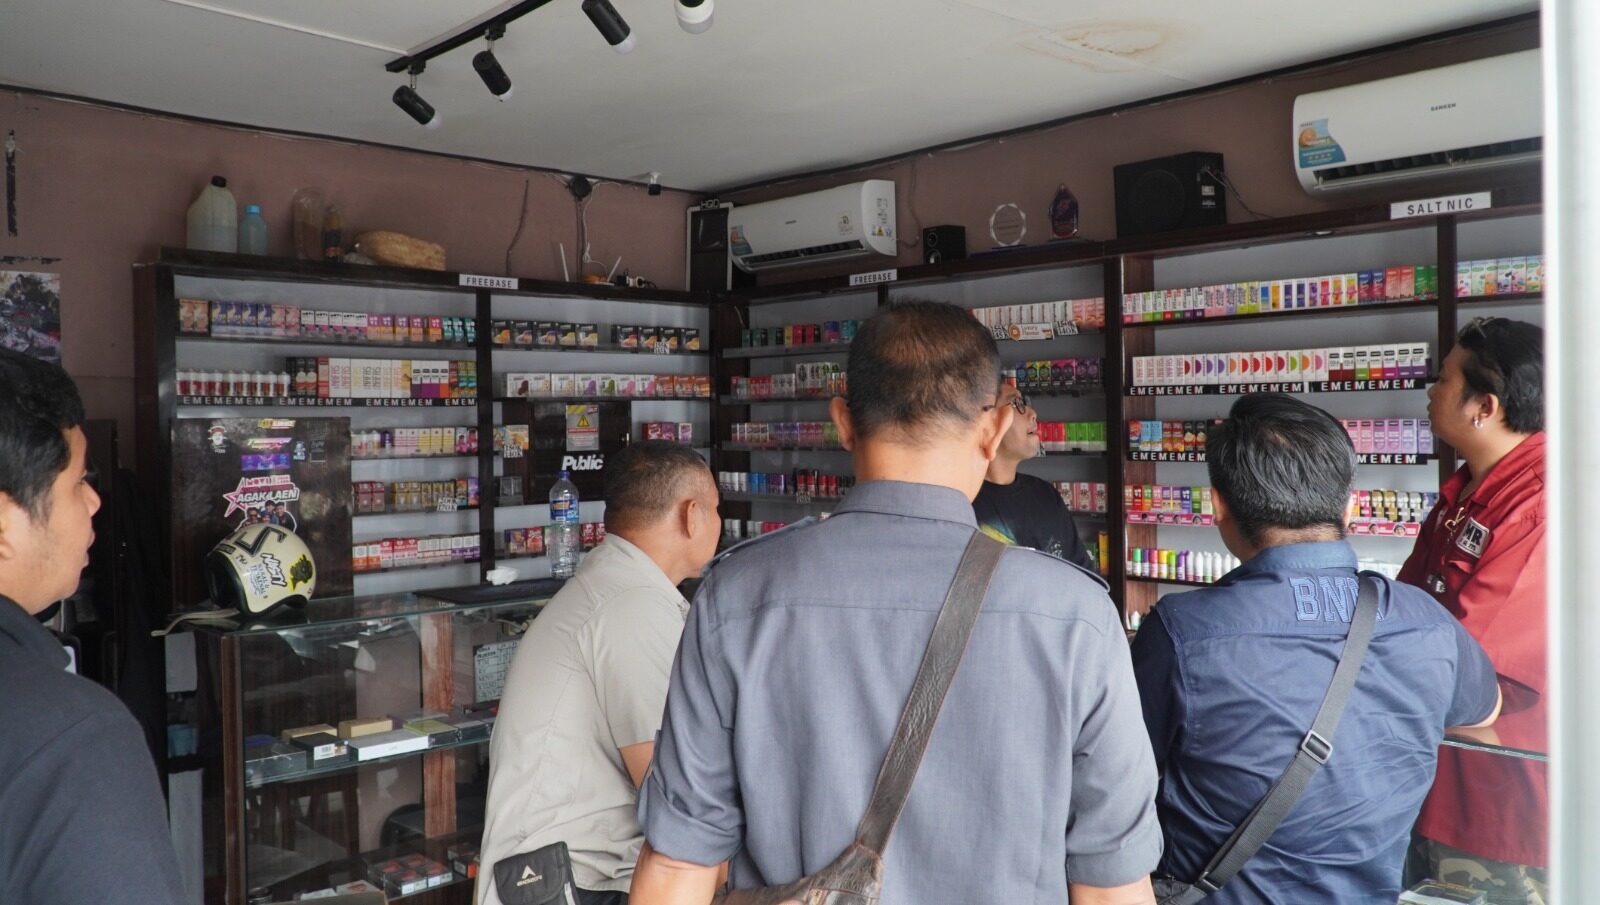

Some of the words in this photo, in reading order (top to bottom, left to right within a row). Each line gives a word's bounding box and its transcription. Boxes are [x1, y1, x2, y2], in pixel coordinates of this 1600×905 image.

[466, 276, 513, 289] FREEBASE
[854, 272, 893, 284] FREEBASE
[561, 454, 604, 471] Public
